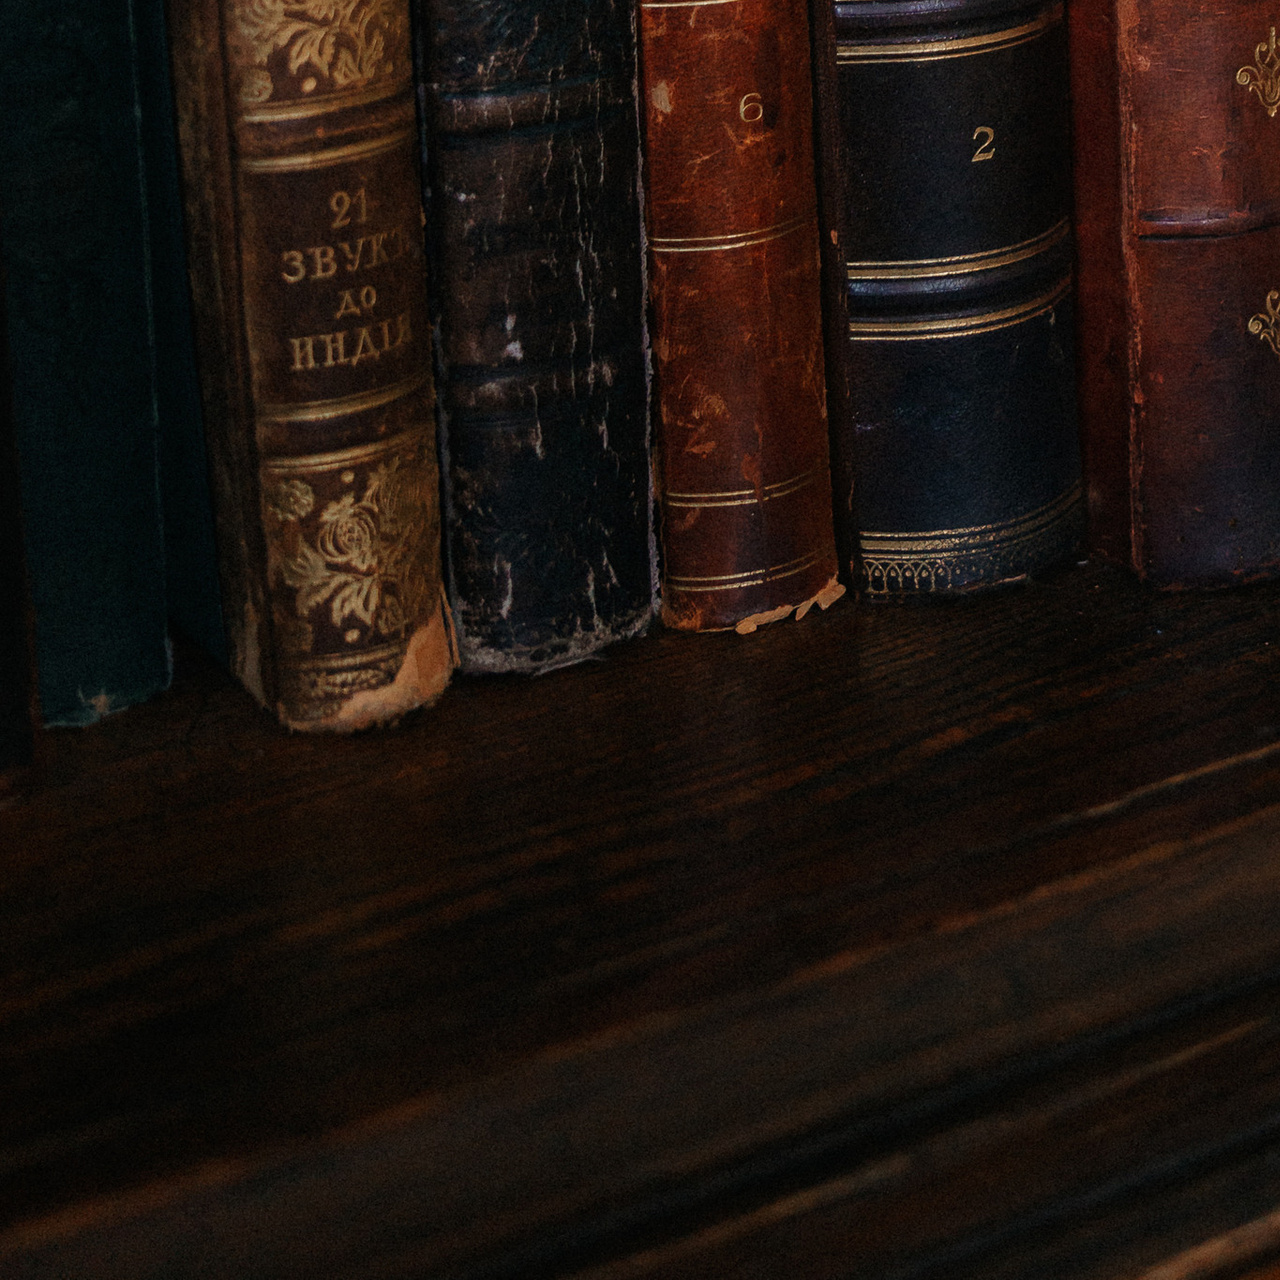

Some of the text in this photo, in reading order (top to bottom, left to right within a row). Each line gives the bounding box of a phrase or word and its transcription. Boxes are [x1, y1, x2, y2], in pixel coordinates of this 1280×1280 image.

[739, 92, 764, 124] 6
[970, 125, 997, 163] 2
[330, 187, 367, 230] 21
